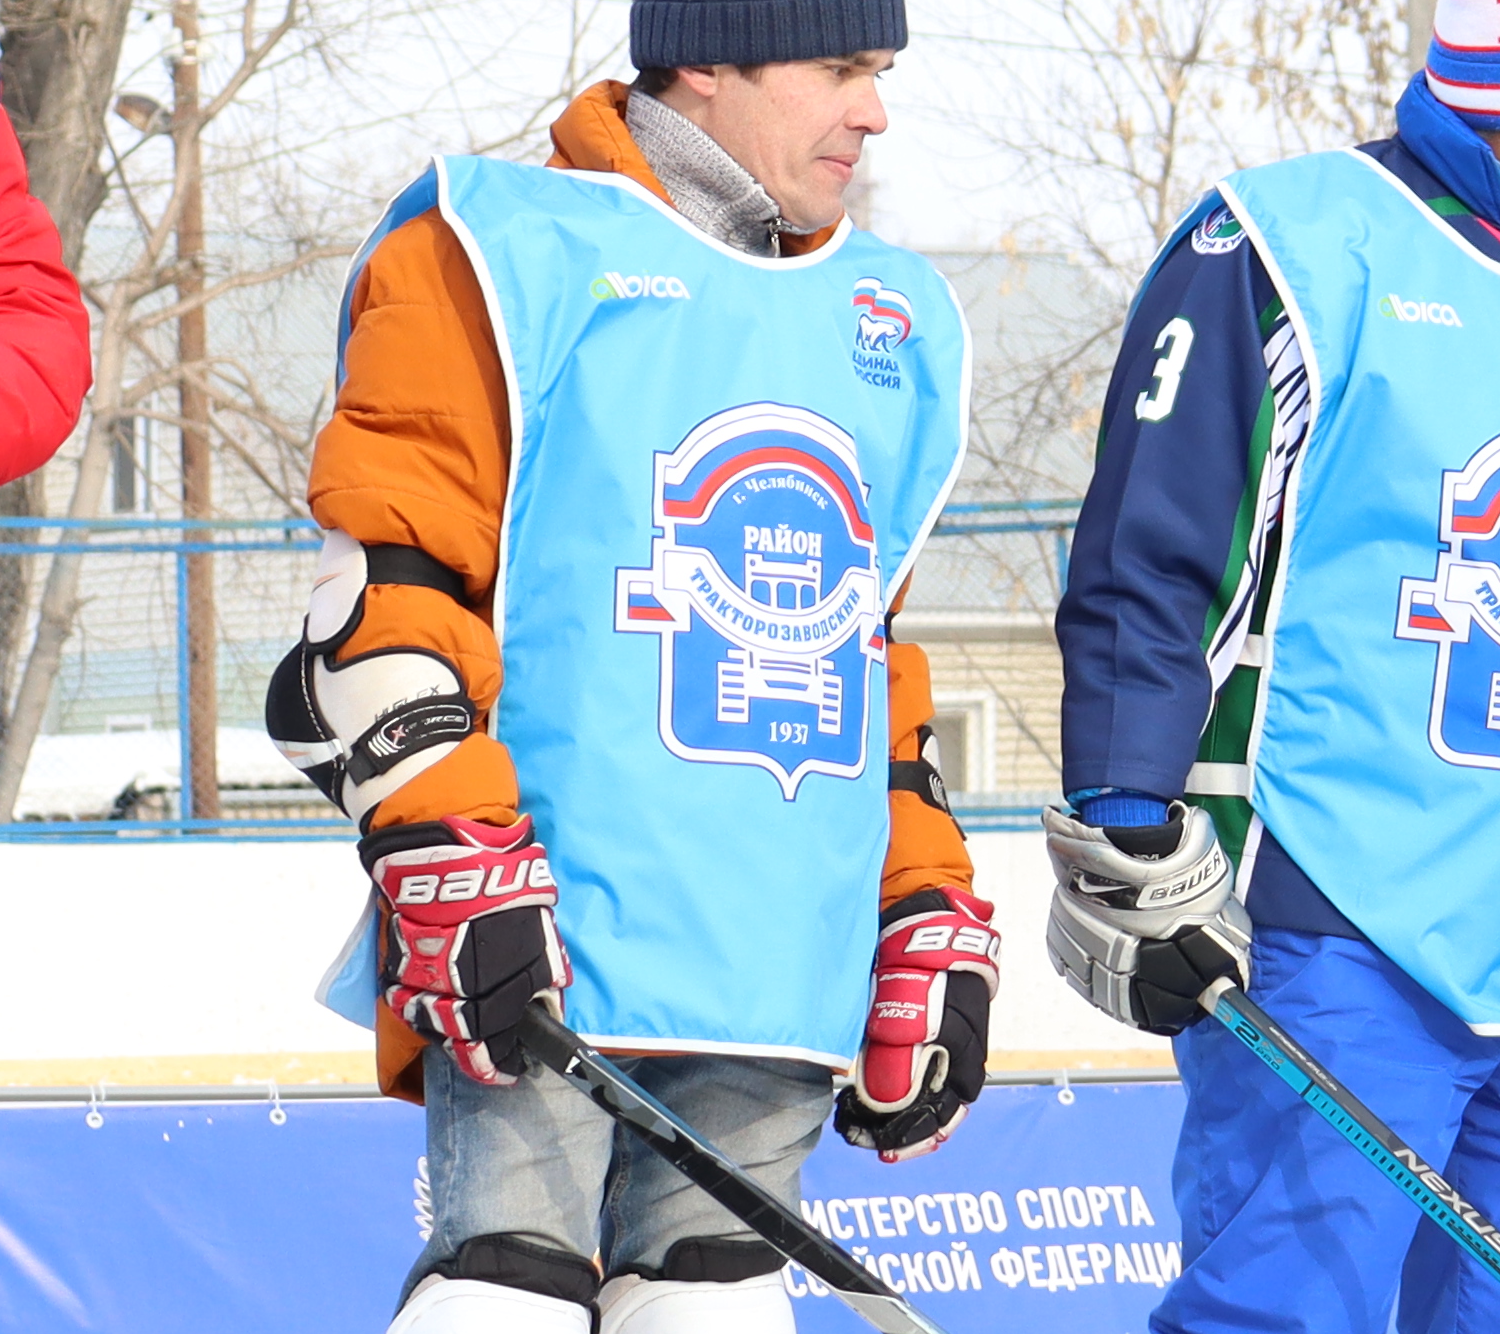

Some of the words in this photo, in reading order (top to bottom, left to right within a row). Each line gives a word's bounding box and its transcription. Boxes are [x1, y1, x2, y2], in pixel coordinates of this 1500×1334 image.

[590, 269, 690, 300] albica
[1378, 293, 1463, 328] albica
[1136, 317, 1194, 422] 3
[746, 475, 830, 512] Челябинск
[743, 522, 823, 558] РАЙОН
[688, 565, 863, 642] ТРАКТОРОЗАВОДСКИЙ
[768, 719, 810, 746] 1937
[394, 857, 559, 905] BAUE
[877, 1008, 918, 1020] MX3
[800, 1189, 1009, 1241] ИСТЕРСТВО
[1015, 1184, 1156, 1230] СПОРТА
[989, 1239, 1184, 1293] ФЕДЕРАЦИ
